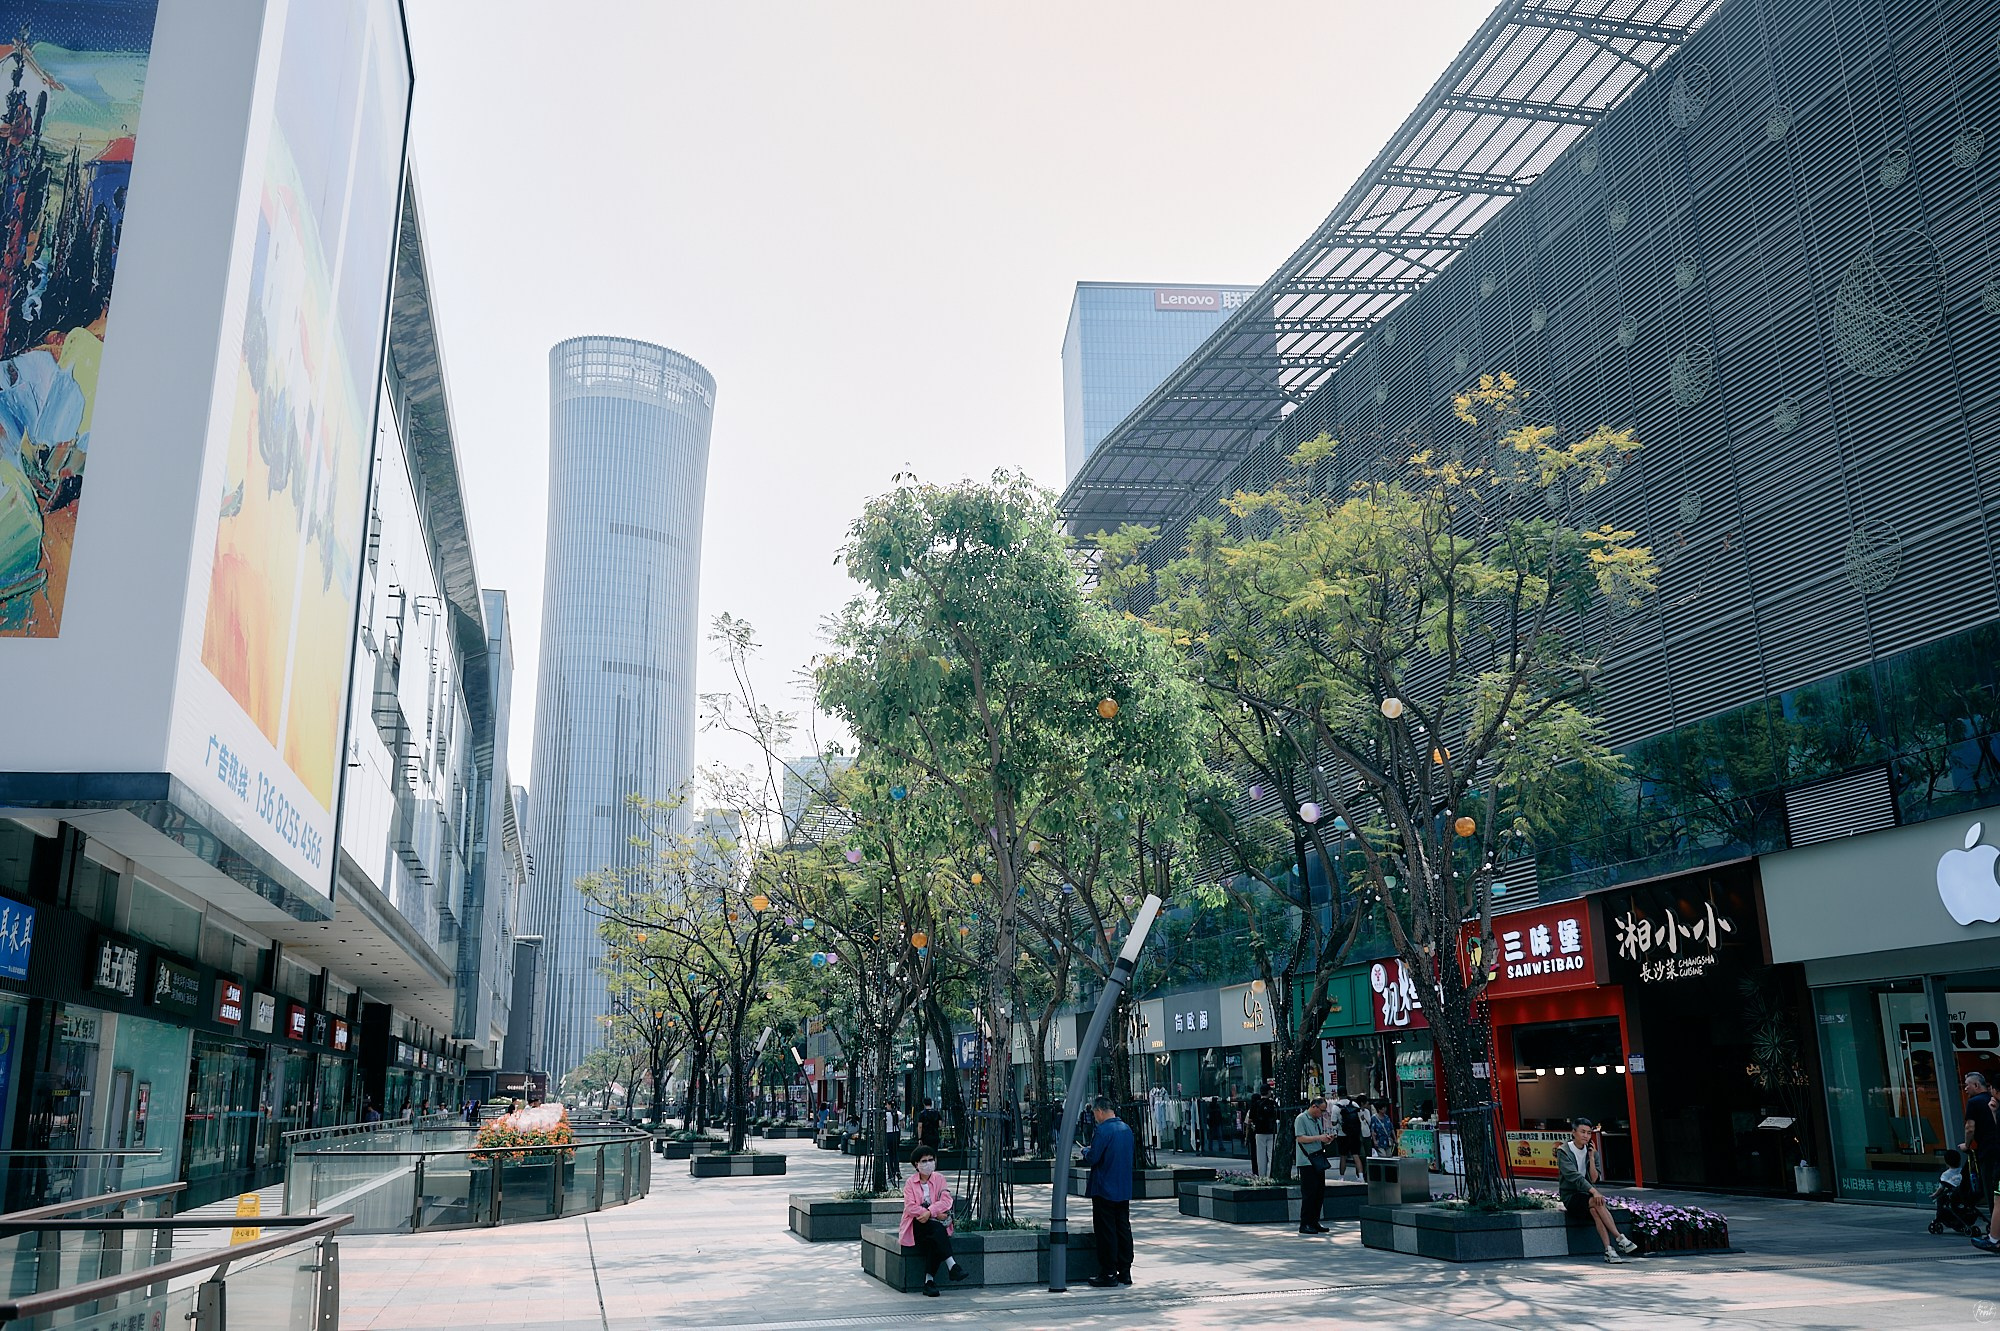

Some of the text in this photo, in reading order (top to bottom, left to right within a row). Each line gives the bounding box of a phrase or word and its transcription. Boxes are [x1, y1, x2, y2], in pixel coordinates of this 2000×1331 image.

[1160, 293, 1215, 306] Lenovo
[205, 734, 322, 869] 广告热线： 136 8255 4566
[1502, 918, 1582, 962] 三味堡
[1614, 902, 1732, 961] 湘小小
[100, 941, 135, 994] 电子烟
[1507, 955, 1584, 979] SANWEIBAO
[1678, 955, 1715, 968] CHANGSHA
[1680, 966, 1703, 978] CUISINE
[1958, 1011, 1967, 1021] 17
[1842, 1178, 1875, 1191] 以旧换新
[1877, 1180, 1913, 1194] 检测维修
